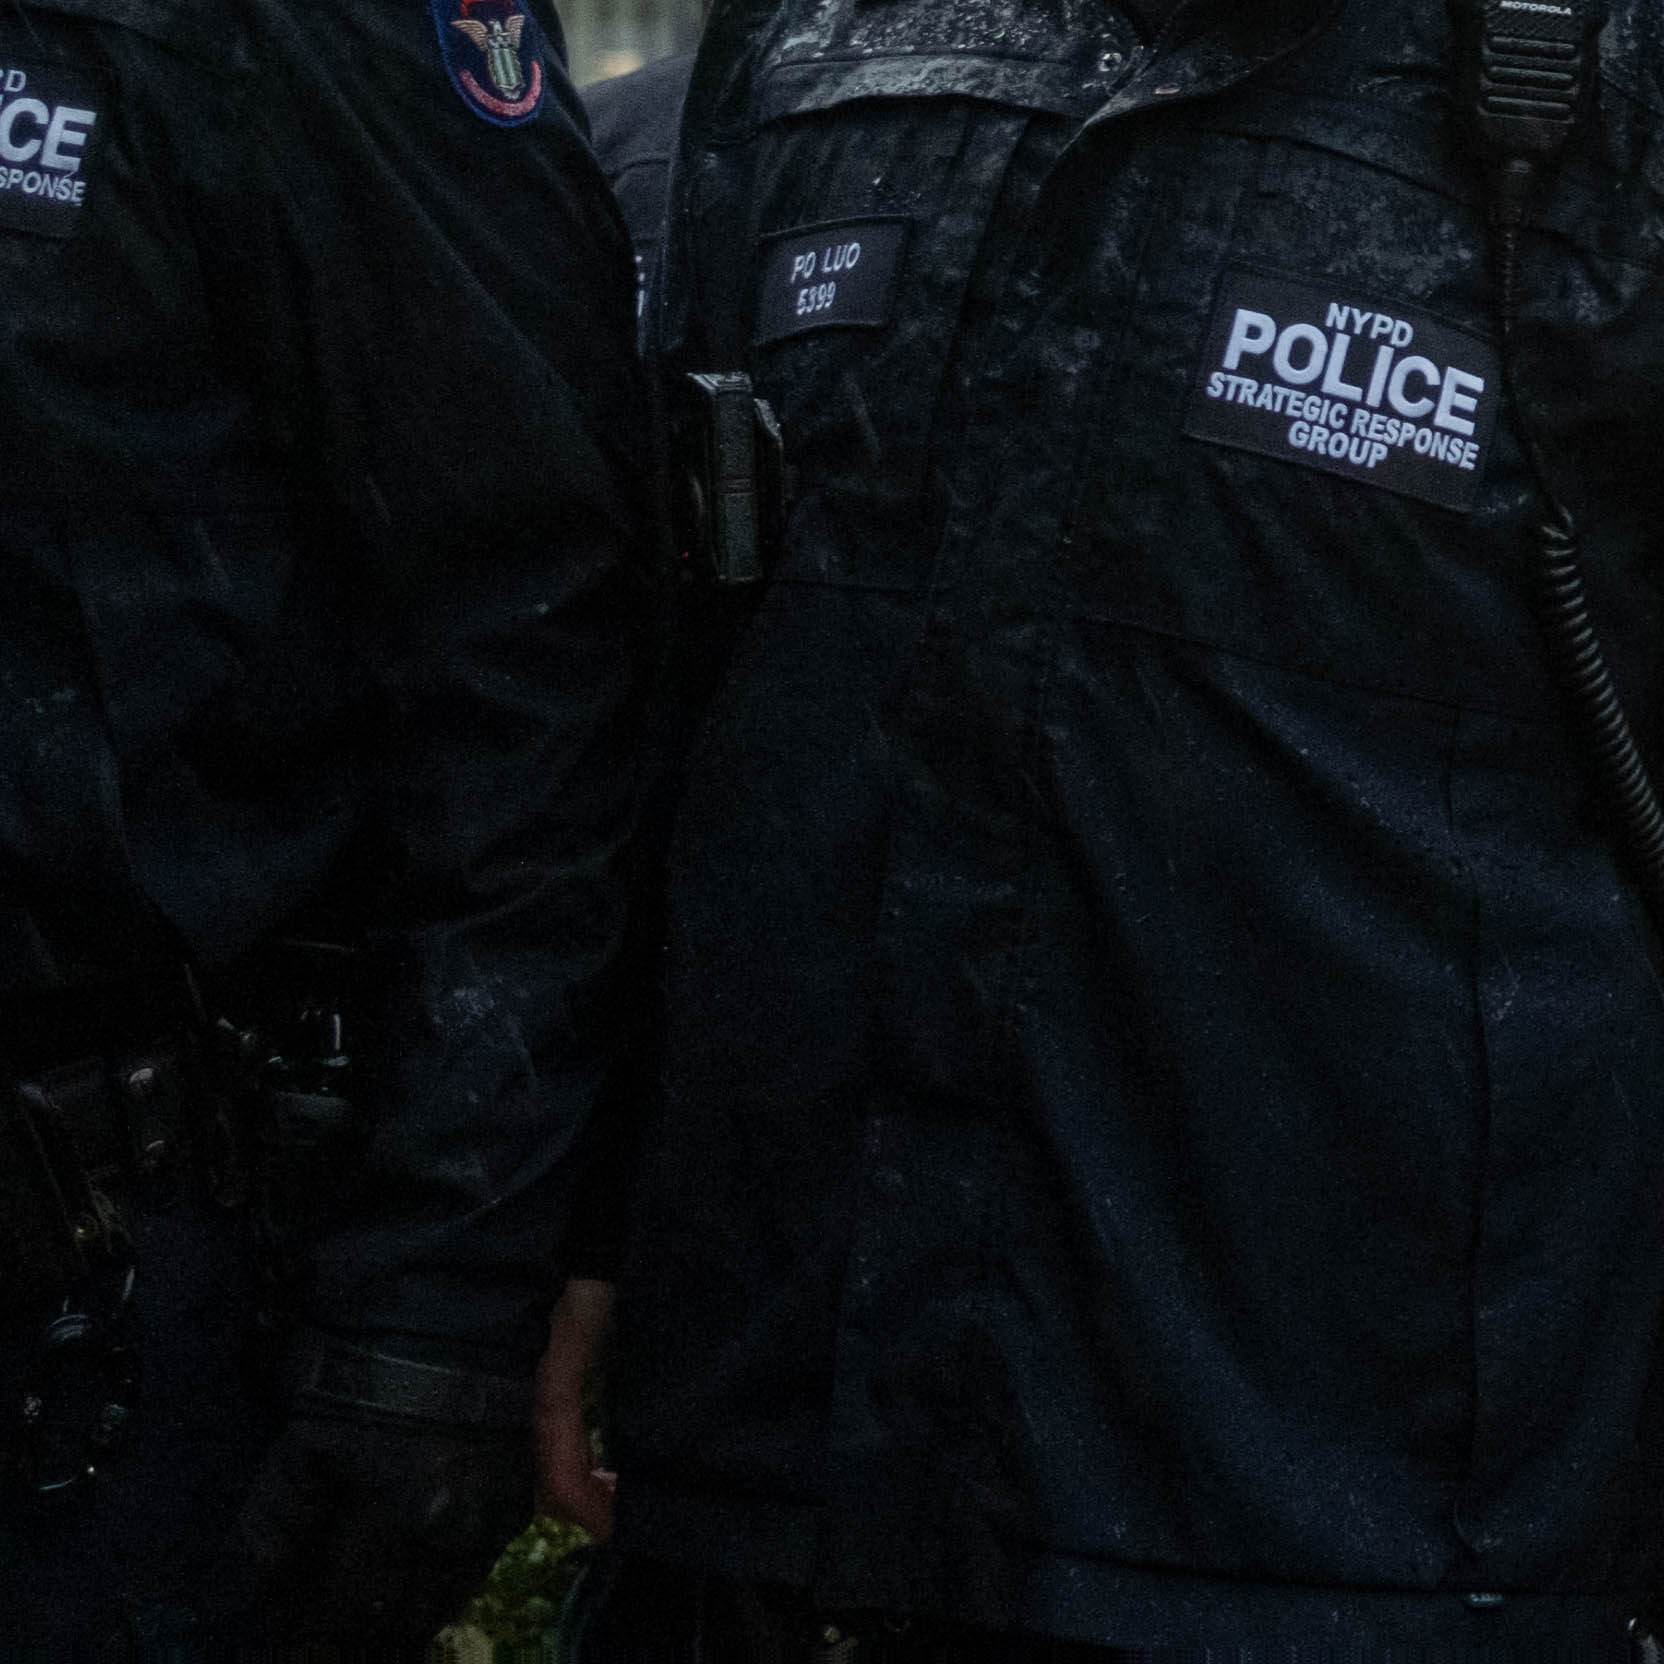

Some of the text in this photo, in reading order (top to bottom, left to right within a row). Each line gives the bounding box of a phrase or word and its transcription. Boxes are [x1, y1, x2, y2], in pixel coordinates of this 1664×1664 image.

[1500, 0, 1572, 15] MOTOROLA
[790, 242, 861, 283] PO LUO
[1325, 302, 1414, 348] NYPD
[1222, 308, 1485, 437] POLICE
[1206, 371, 1480, 471] STRATEGIC RESPONSE
[1287, 421, 1389, 469] GROUP
